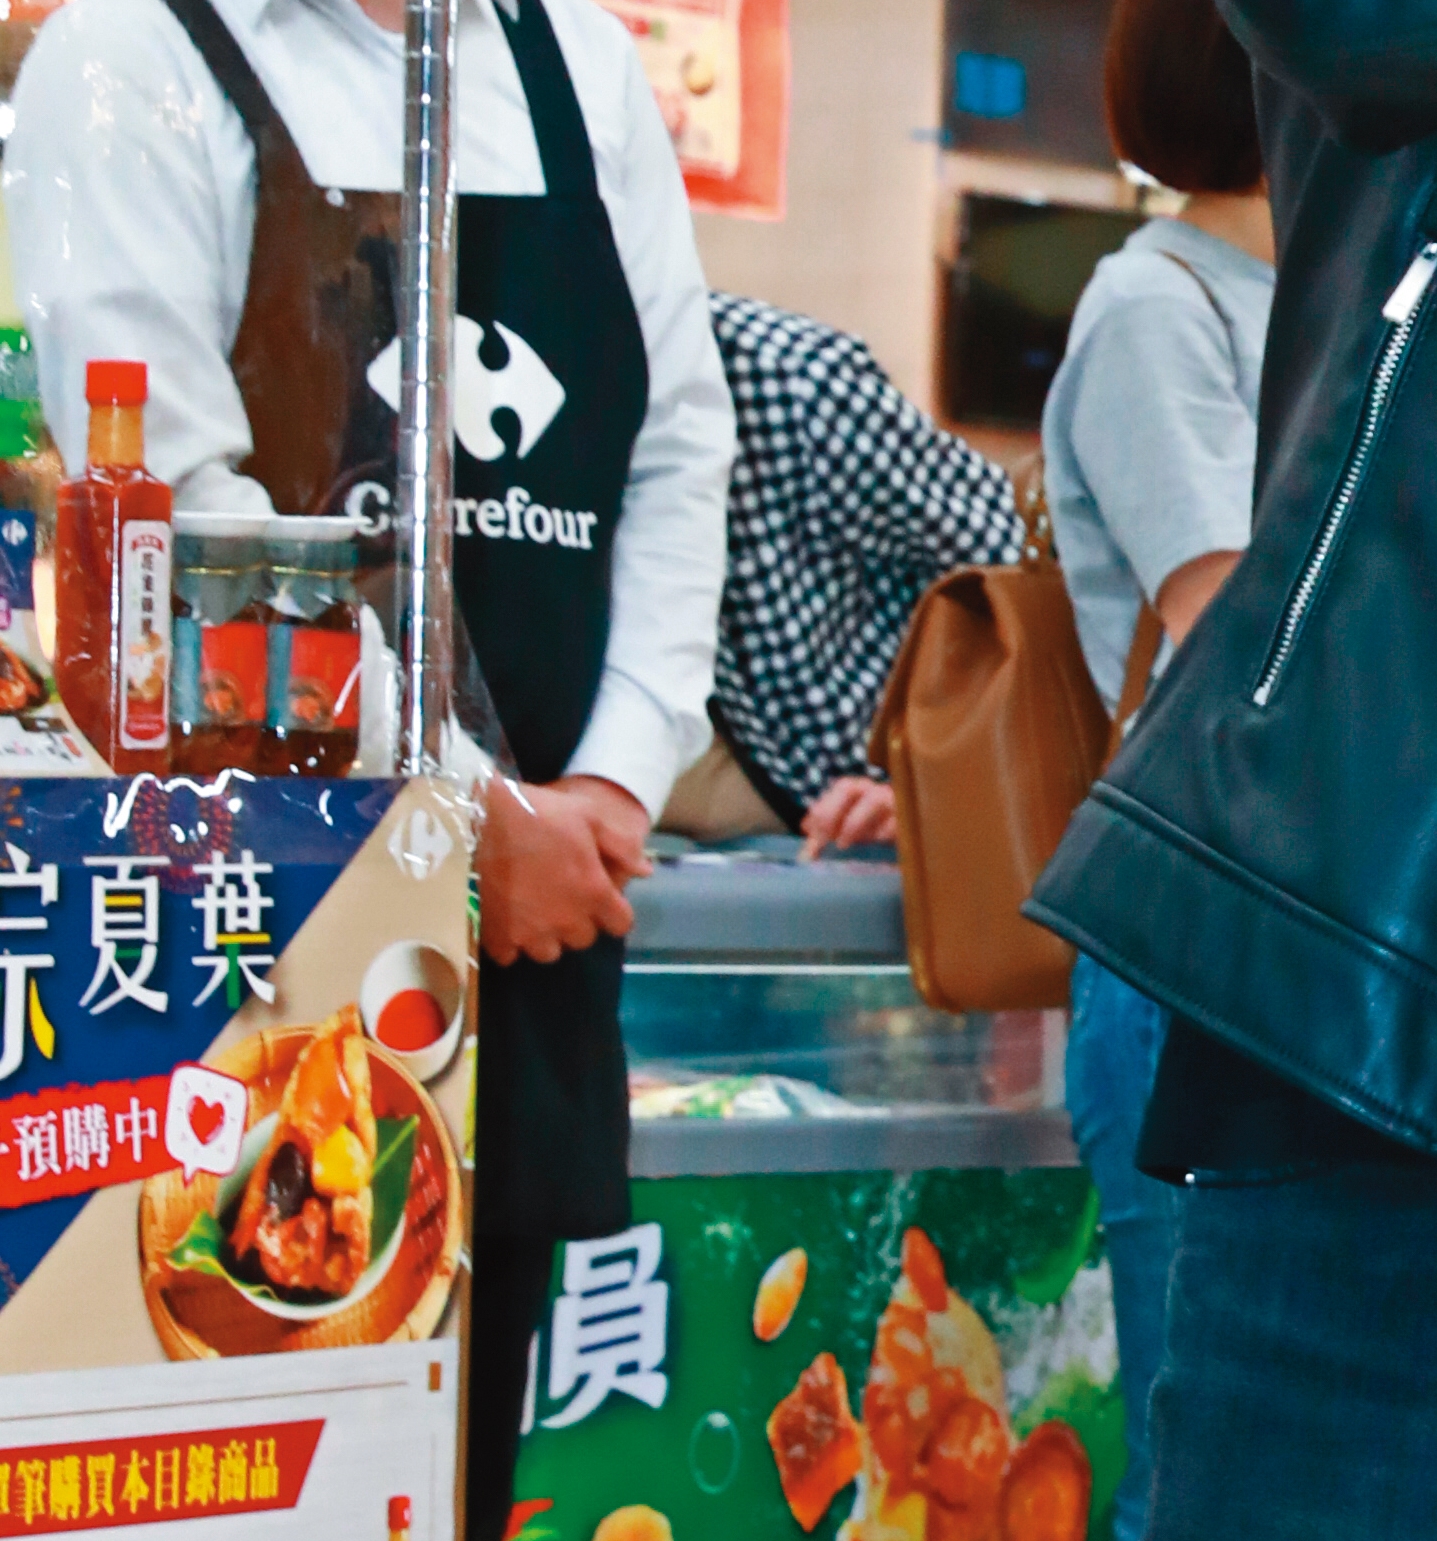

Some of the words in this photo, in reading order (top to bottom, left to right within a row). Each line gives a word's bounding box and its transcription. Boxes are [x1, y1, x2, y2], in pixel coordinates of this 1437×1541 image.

[344, 480, 599, 550] Crefour
[0, 1096, 158, 1182] 預購中
